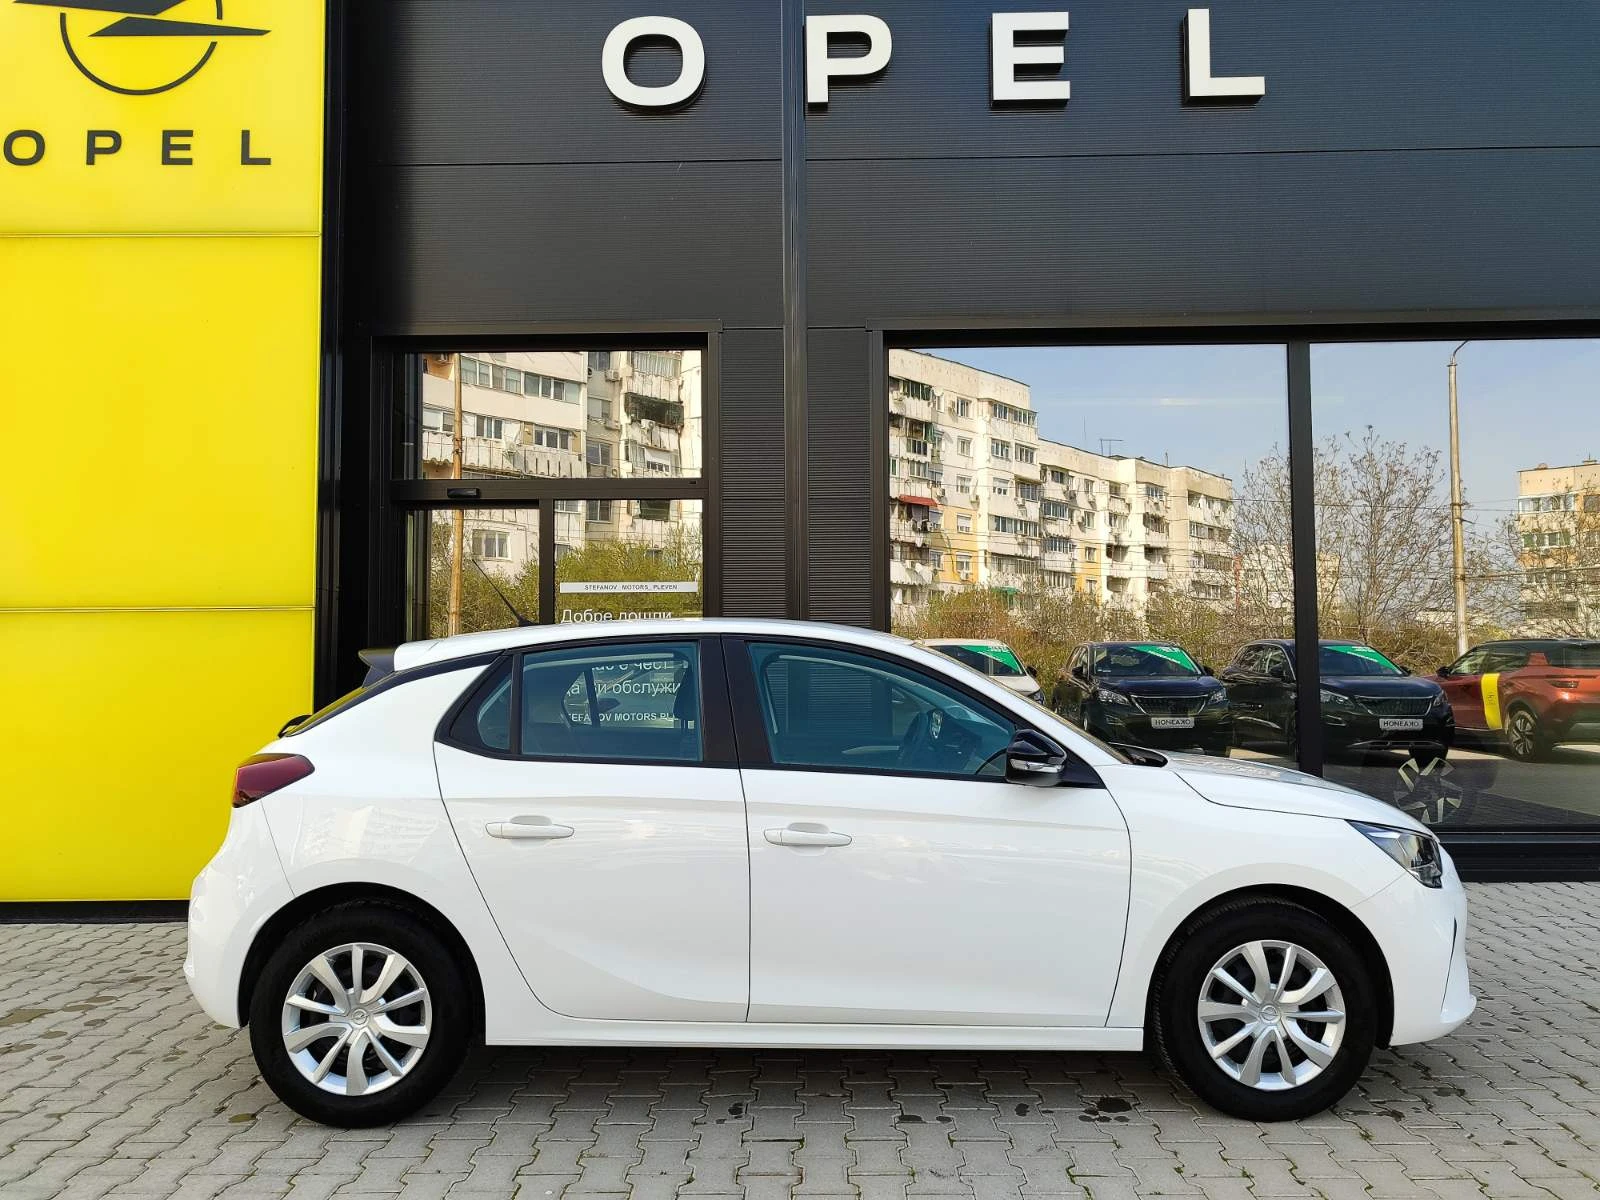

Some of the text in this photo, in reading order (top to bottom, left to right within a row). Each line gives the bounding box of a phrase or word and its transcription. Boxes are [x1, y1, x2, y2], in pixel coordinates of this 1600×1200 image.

[601, 8, 1266, 107] OPEL
[3, 129, 272, 166] OPEL
[560, 609, 612, 624] Добре
[614, 712, 657, 721] MOTORS
